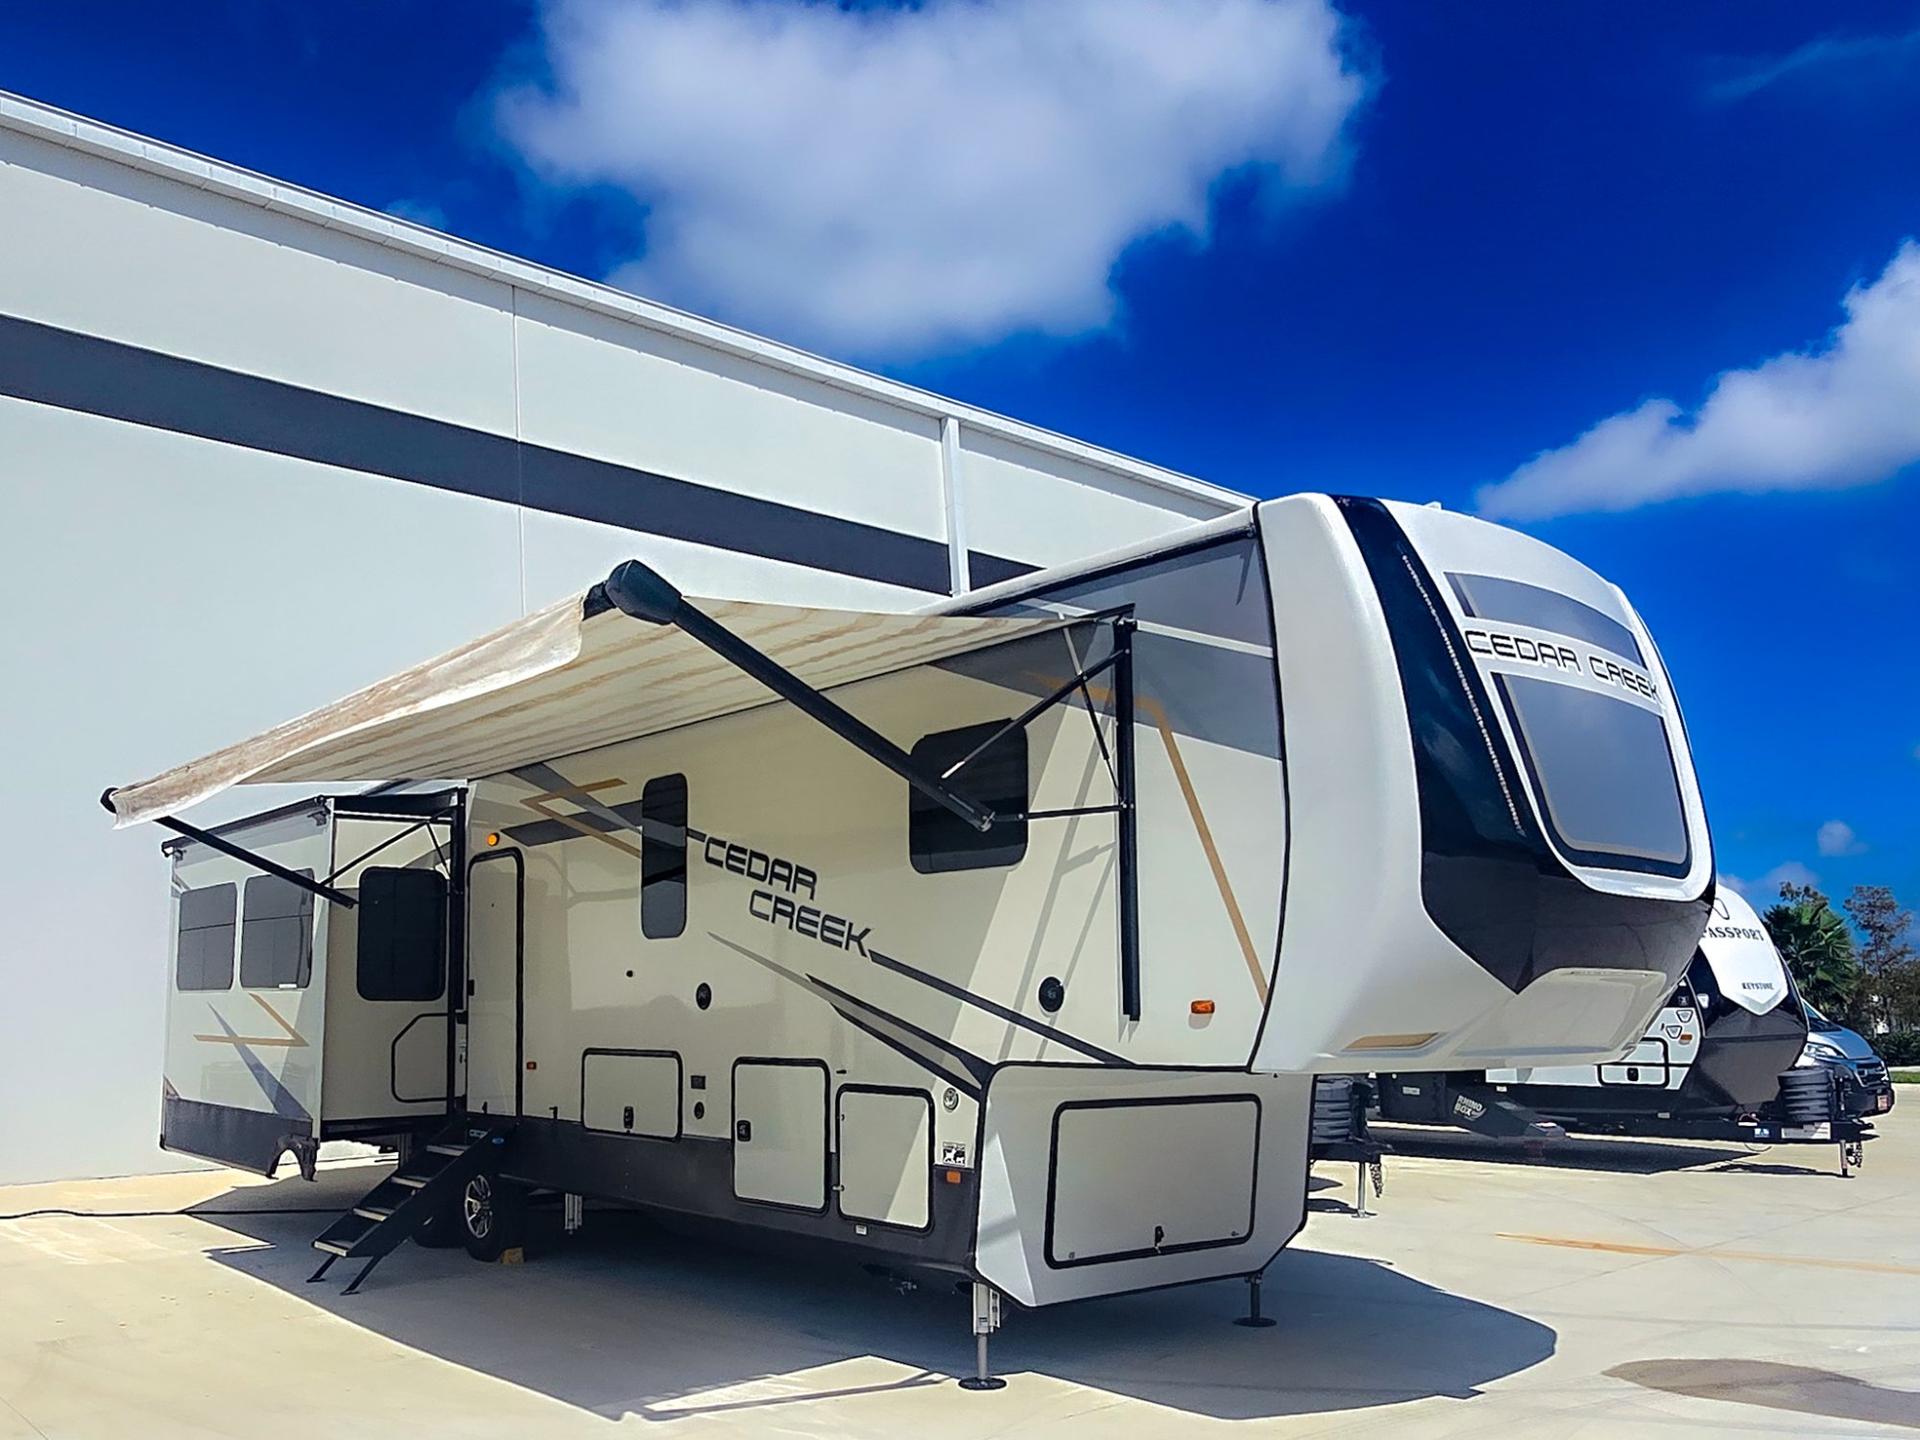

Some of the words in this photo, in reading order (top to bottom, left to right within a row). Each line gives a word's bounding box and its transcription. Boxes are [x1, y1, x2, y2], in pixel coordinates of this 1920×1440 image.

[1465, 630, 1581, 672] CEDAR
[1589, 656, 1659, 700] CREEK
[705, 837, 817, 900] CEDAR
[750, 889, 871, 957] CREEK
[1454, 1103, 1471, 1117] BOX
